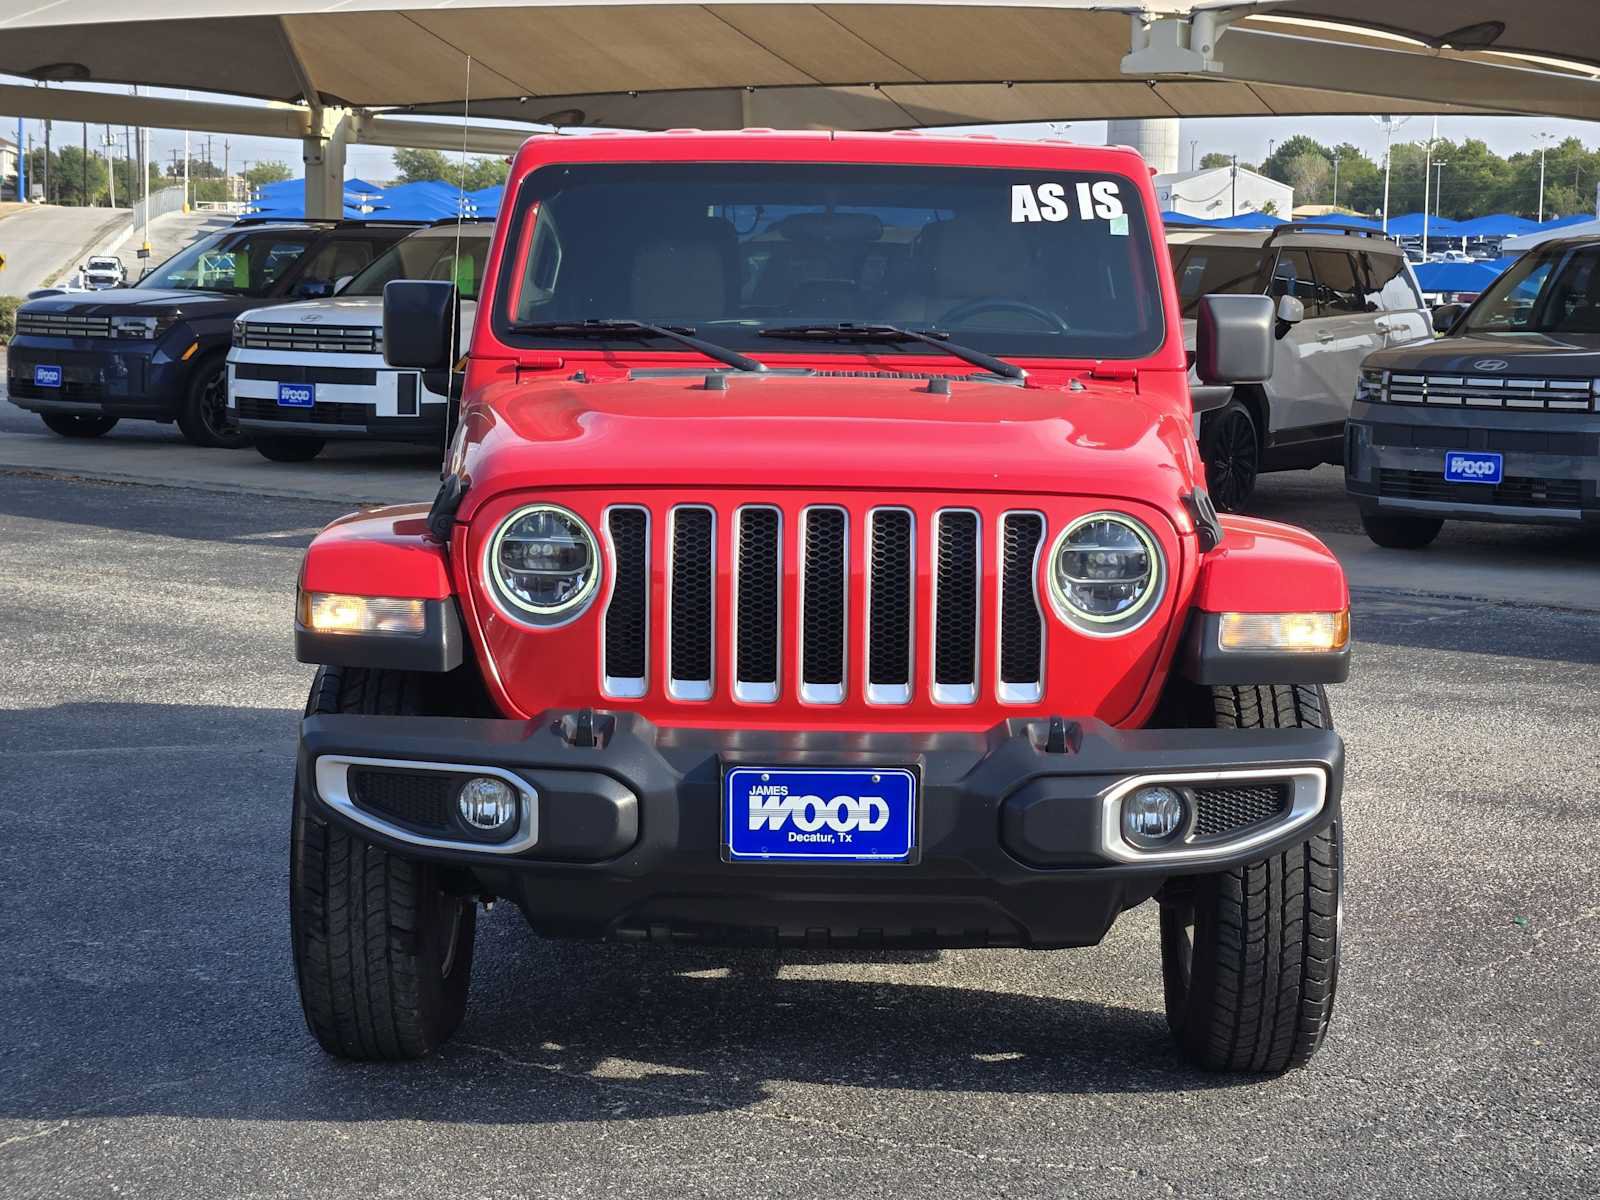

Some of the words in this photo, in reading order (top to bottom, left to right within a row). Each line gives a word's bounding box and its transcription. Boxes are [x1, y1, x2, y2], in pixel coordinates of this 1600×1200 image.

[1011, 183, 1069, 223] AS
[1075, 181, 1123, 220] IS
[281, 389, 310, 401] WOOD
[1451, 459, 1495, 475] WOOD
[749, 785, 788, 796] JAMES
[748, 795, 890, 832] WOOD
[788, 832, 835, 844] Decatur,
[838, 832, 852, 843] Tx
